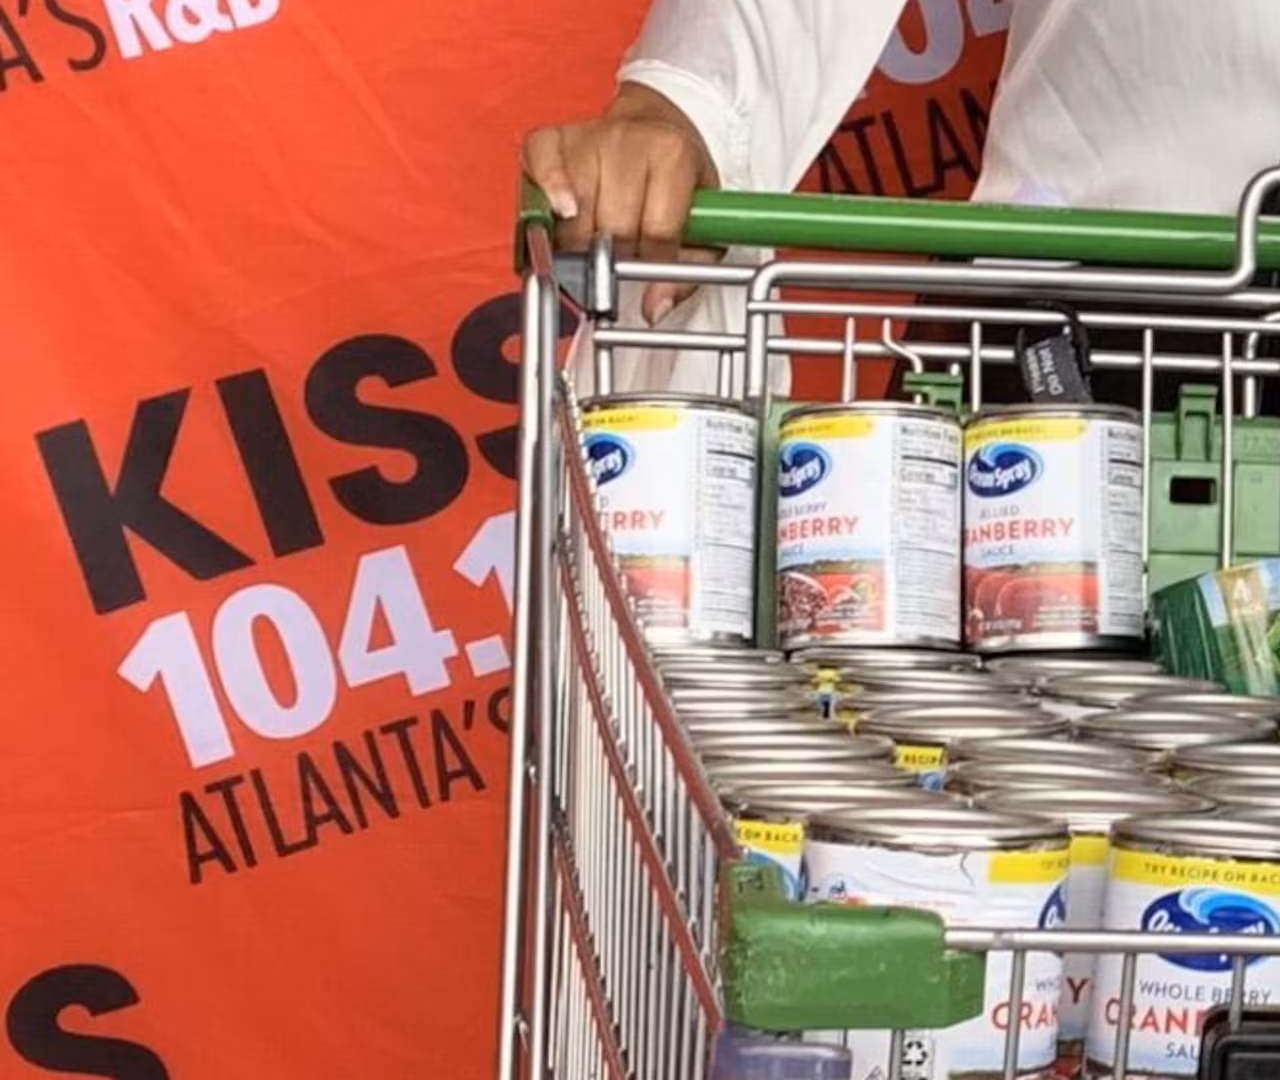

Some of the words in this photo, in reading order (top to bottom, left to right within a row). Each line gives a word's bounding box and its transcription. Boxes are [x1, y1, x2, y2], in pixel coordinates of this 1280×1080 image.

[995, 458, 1031, 490] Spray
[1145, 863, 1167, 875] TRY
[1171, 867, 1219, 880] RECIPE
[1223, 871, 1246, 883] ON
[1138, 979, 1205, 1000] WHOLE
[1210, 986, 1272, 1004] BERY
